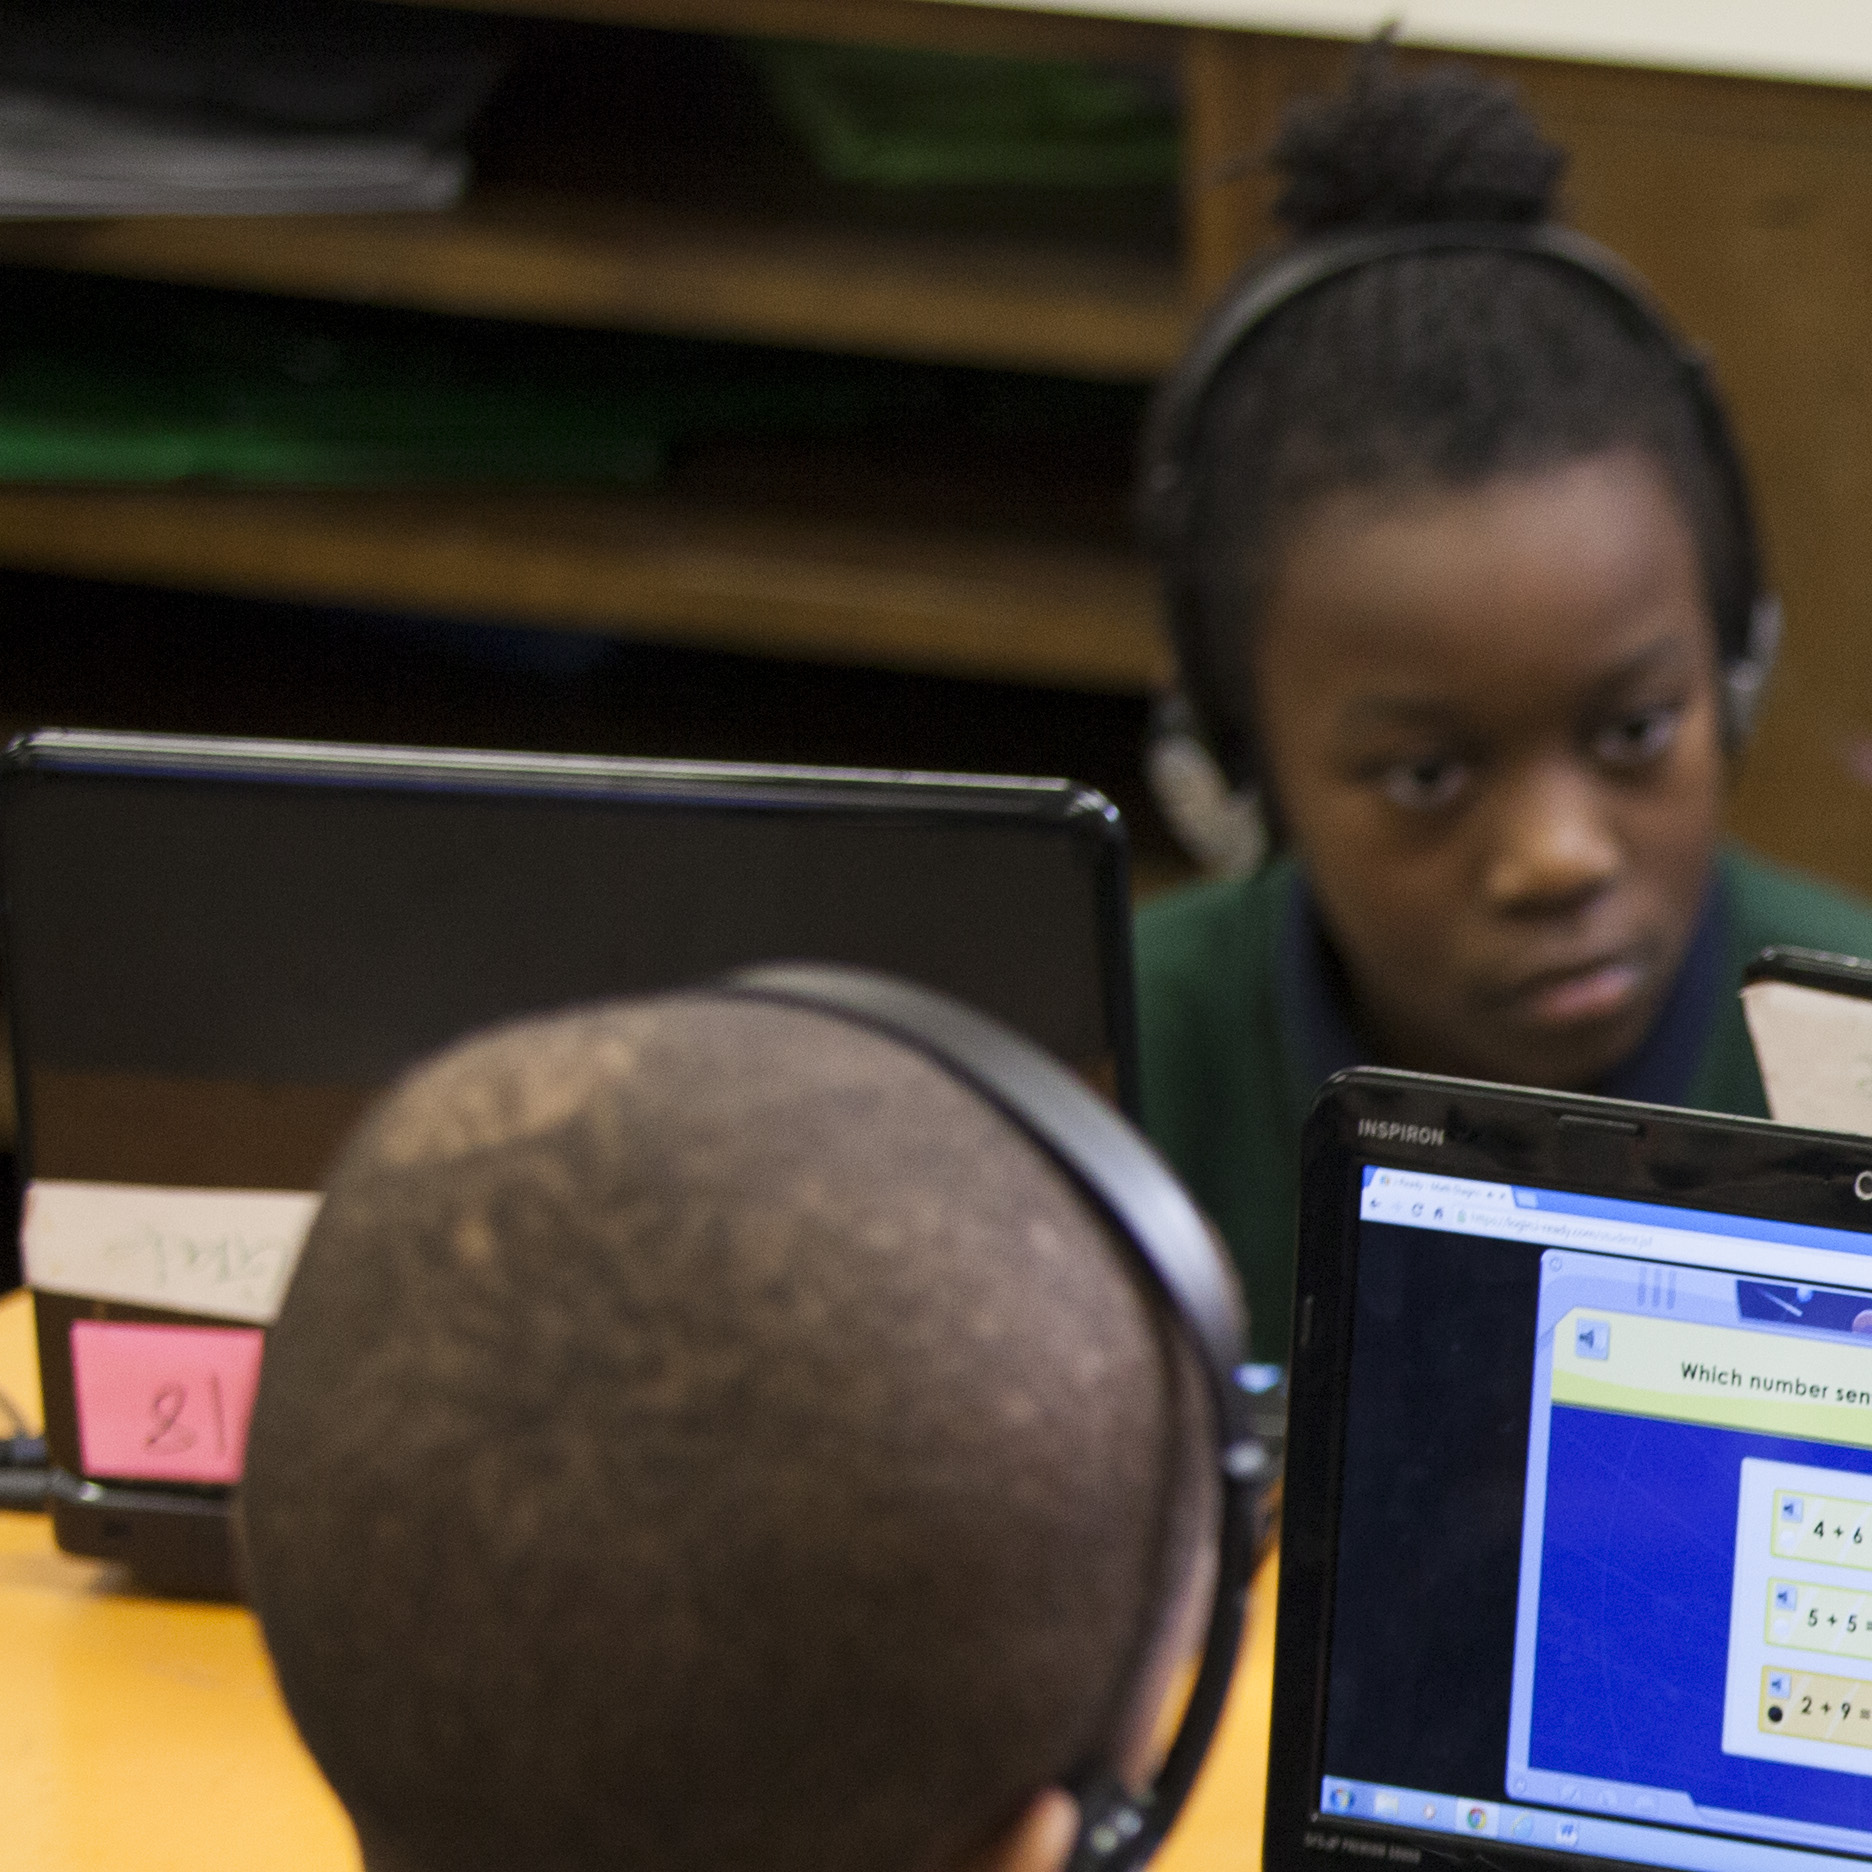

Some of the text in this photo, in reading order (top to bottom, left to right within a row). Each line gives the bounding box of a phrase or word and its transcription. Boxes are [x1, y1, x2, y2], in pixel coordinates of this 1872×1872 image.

[1357, 1118, 1446, 1147] INSPIRON
[1680, 1360, 1742, 1387] Which
[1750, 1375, 1829, 1400] number
[1814, 1520, 1825, 1539] 4
[1833, 1527, 1844, 1538] +
[1853, 1527, 1863, 1545] 6
[1808, 1608, 1818, 1627] 5
[1827, 1614, 1838, 1626] +
[1847, 1615, 1857, 1633] 5
[1801, 1696, 1813, 1715] 2
[1821, 1702, 1831, 1714] +
[1841, 1703, 1851, 1720] 9
[1860, 1709, 1871, 1720] =
